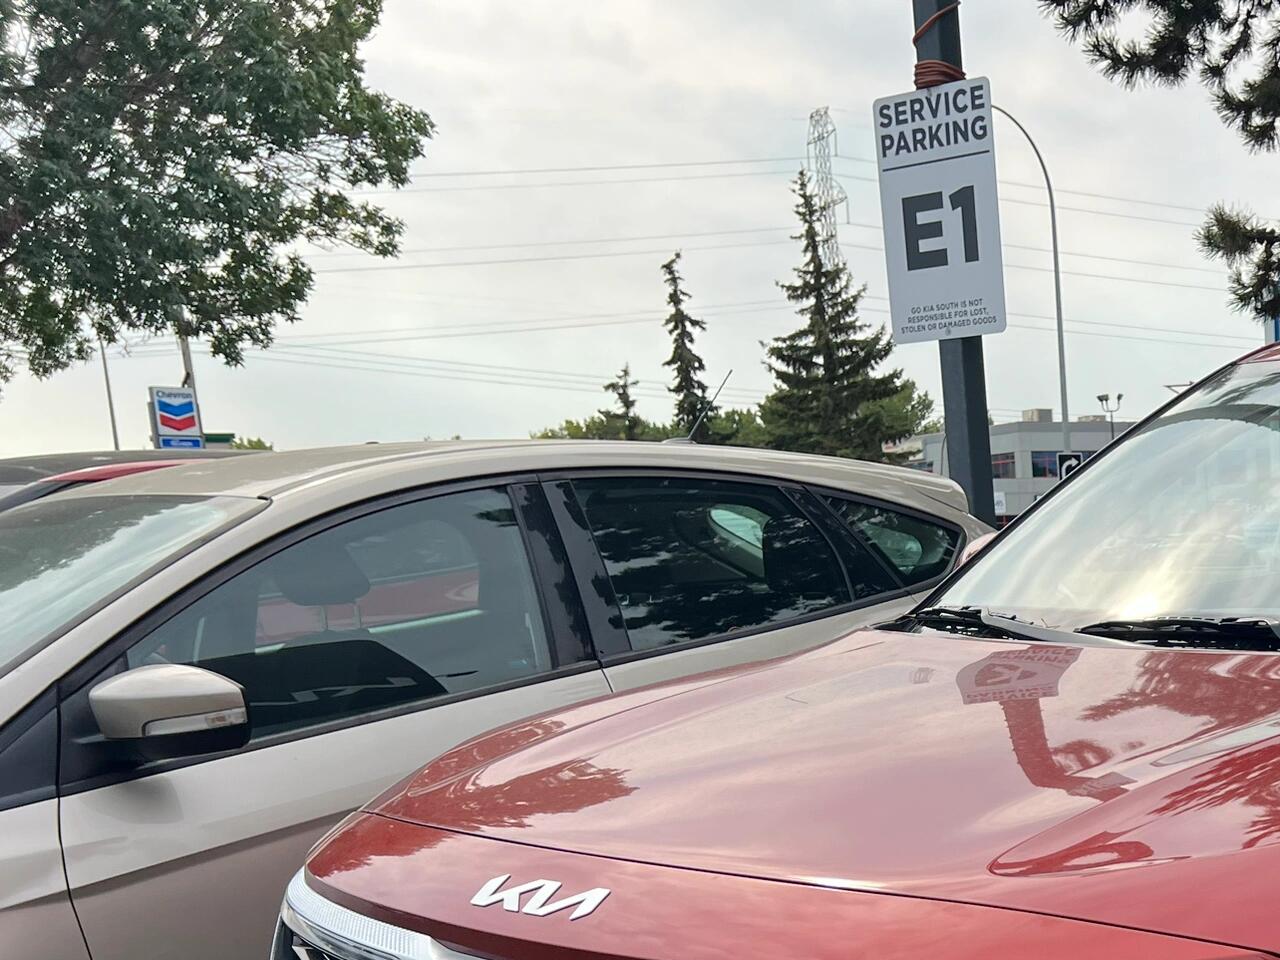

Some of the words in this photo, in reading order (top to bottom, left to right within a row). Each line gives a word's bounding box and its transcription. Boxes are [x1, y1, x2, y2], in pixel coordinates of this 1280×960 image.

[879, 84, 985, 128] SERVICE
[881, 115, 987, 158] PARKING
[901, 184, 979, 271] E1
[901, 325, 926, 334] STOLEN
[927, 323, 937, 331] OR
[938, 319, 971, 329] DAMAGED
[972, 316, 997, 325] GOODS
[907, 311, 952, 324] RESPONSIBLE
[954, 310, 968, 318] FOR
[911, 306, 921, 314] GO
[936, 302, 958, 311] SOUTH
[960, 300, 967, 308] IS
[969, 298, 983, 306] NOT
[470, 873, 611, 921] KIA
